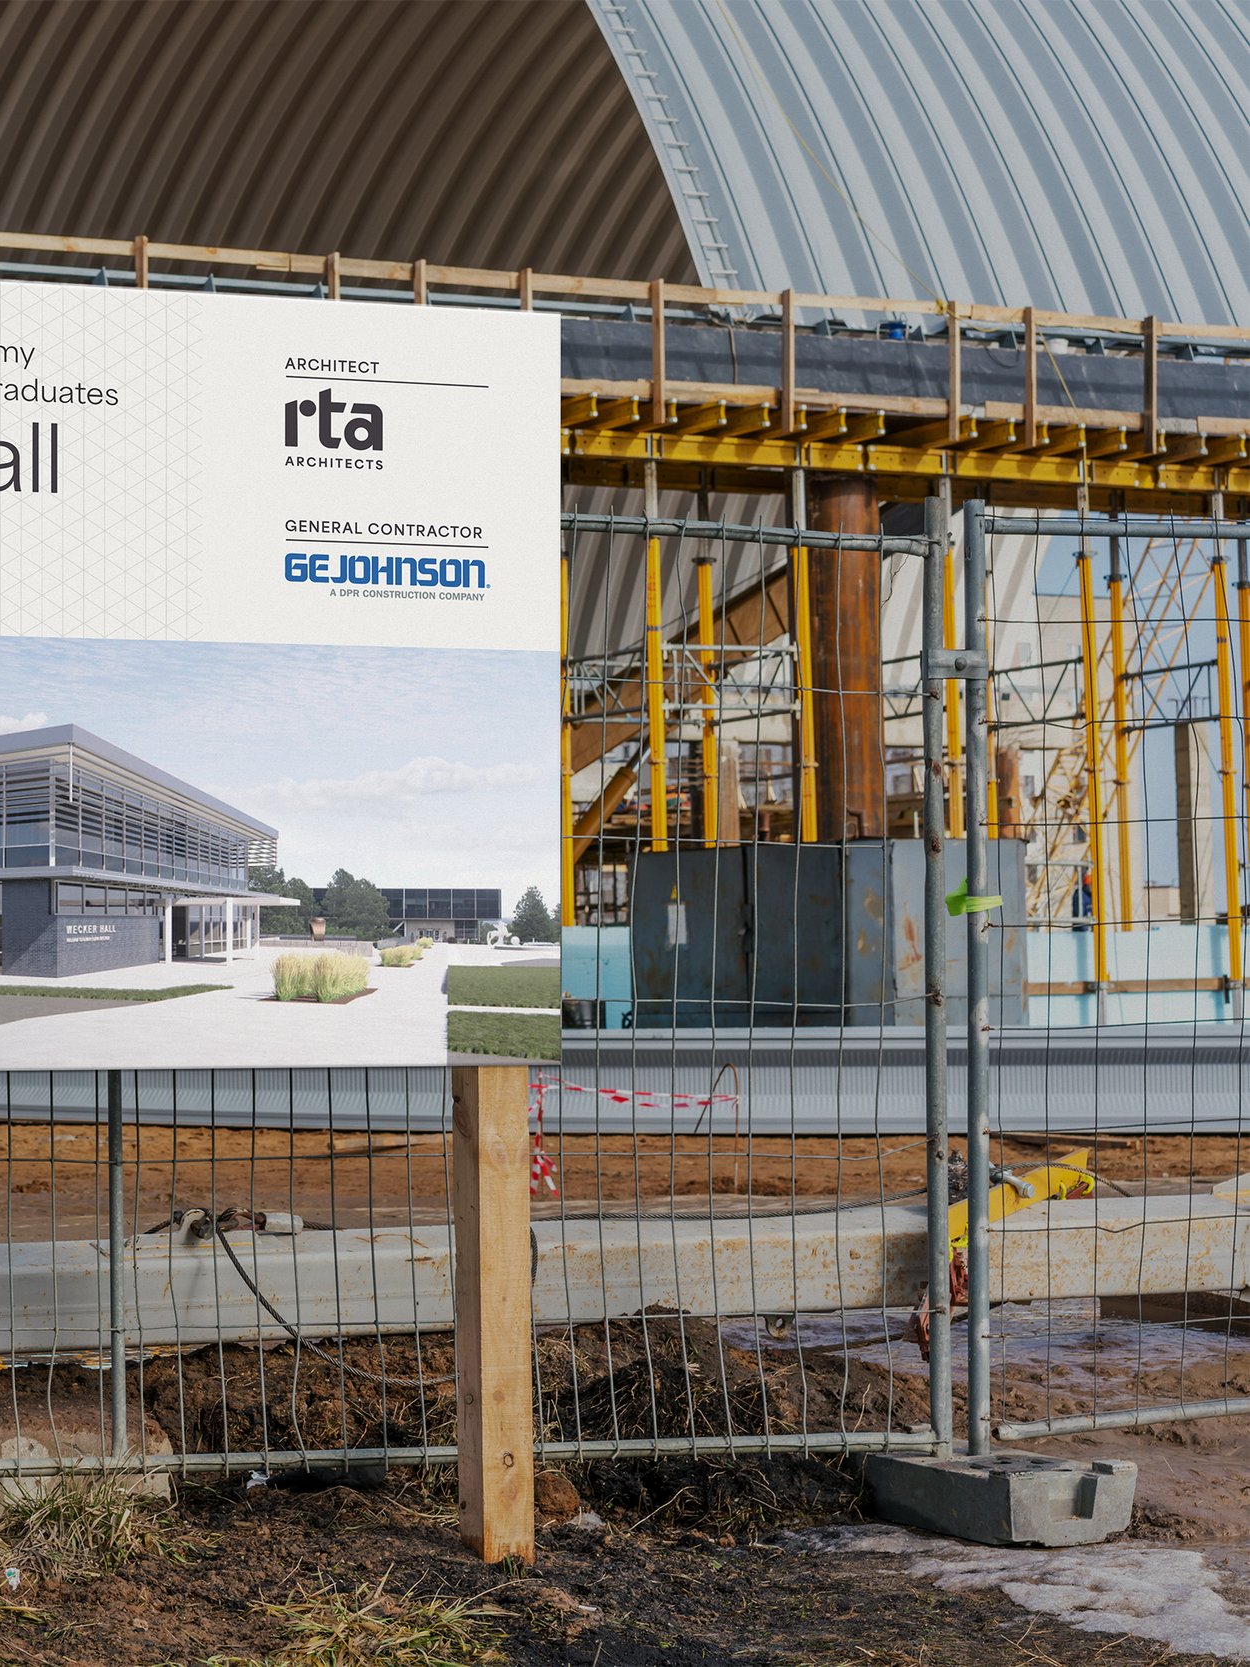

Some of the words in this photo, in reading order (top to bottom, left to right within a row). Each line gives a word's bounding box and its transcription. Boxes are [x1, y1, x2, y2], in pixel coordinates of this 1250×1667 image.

[284, 357, 380, 375] ARCHITECT
[284, 387, 384, 452] rta
[284, 455, 384, 471] ARCHITECTS
[284, 519, 363, 535] GENERAL
[367, 522, 483, 540] CONTRACTOR
[329, 588, 337, 597] A
[339, 588, 360, 598] DPR
[362, 589, 436, 600] CONSTRUCTION
[438, 591, 486, 602] COMPANY
[66, 924, 98, 934] WECKER
[99, 924, 116, 933] HALL
